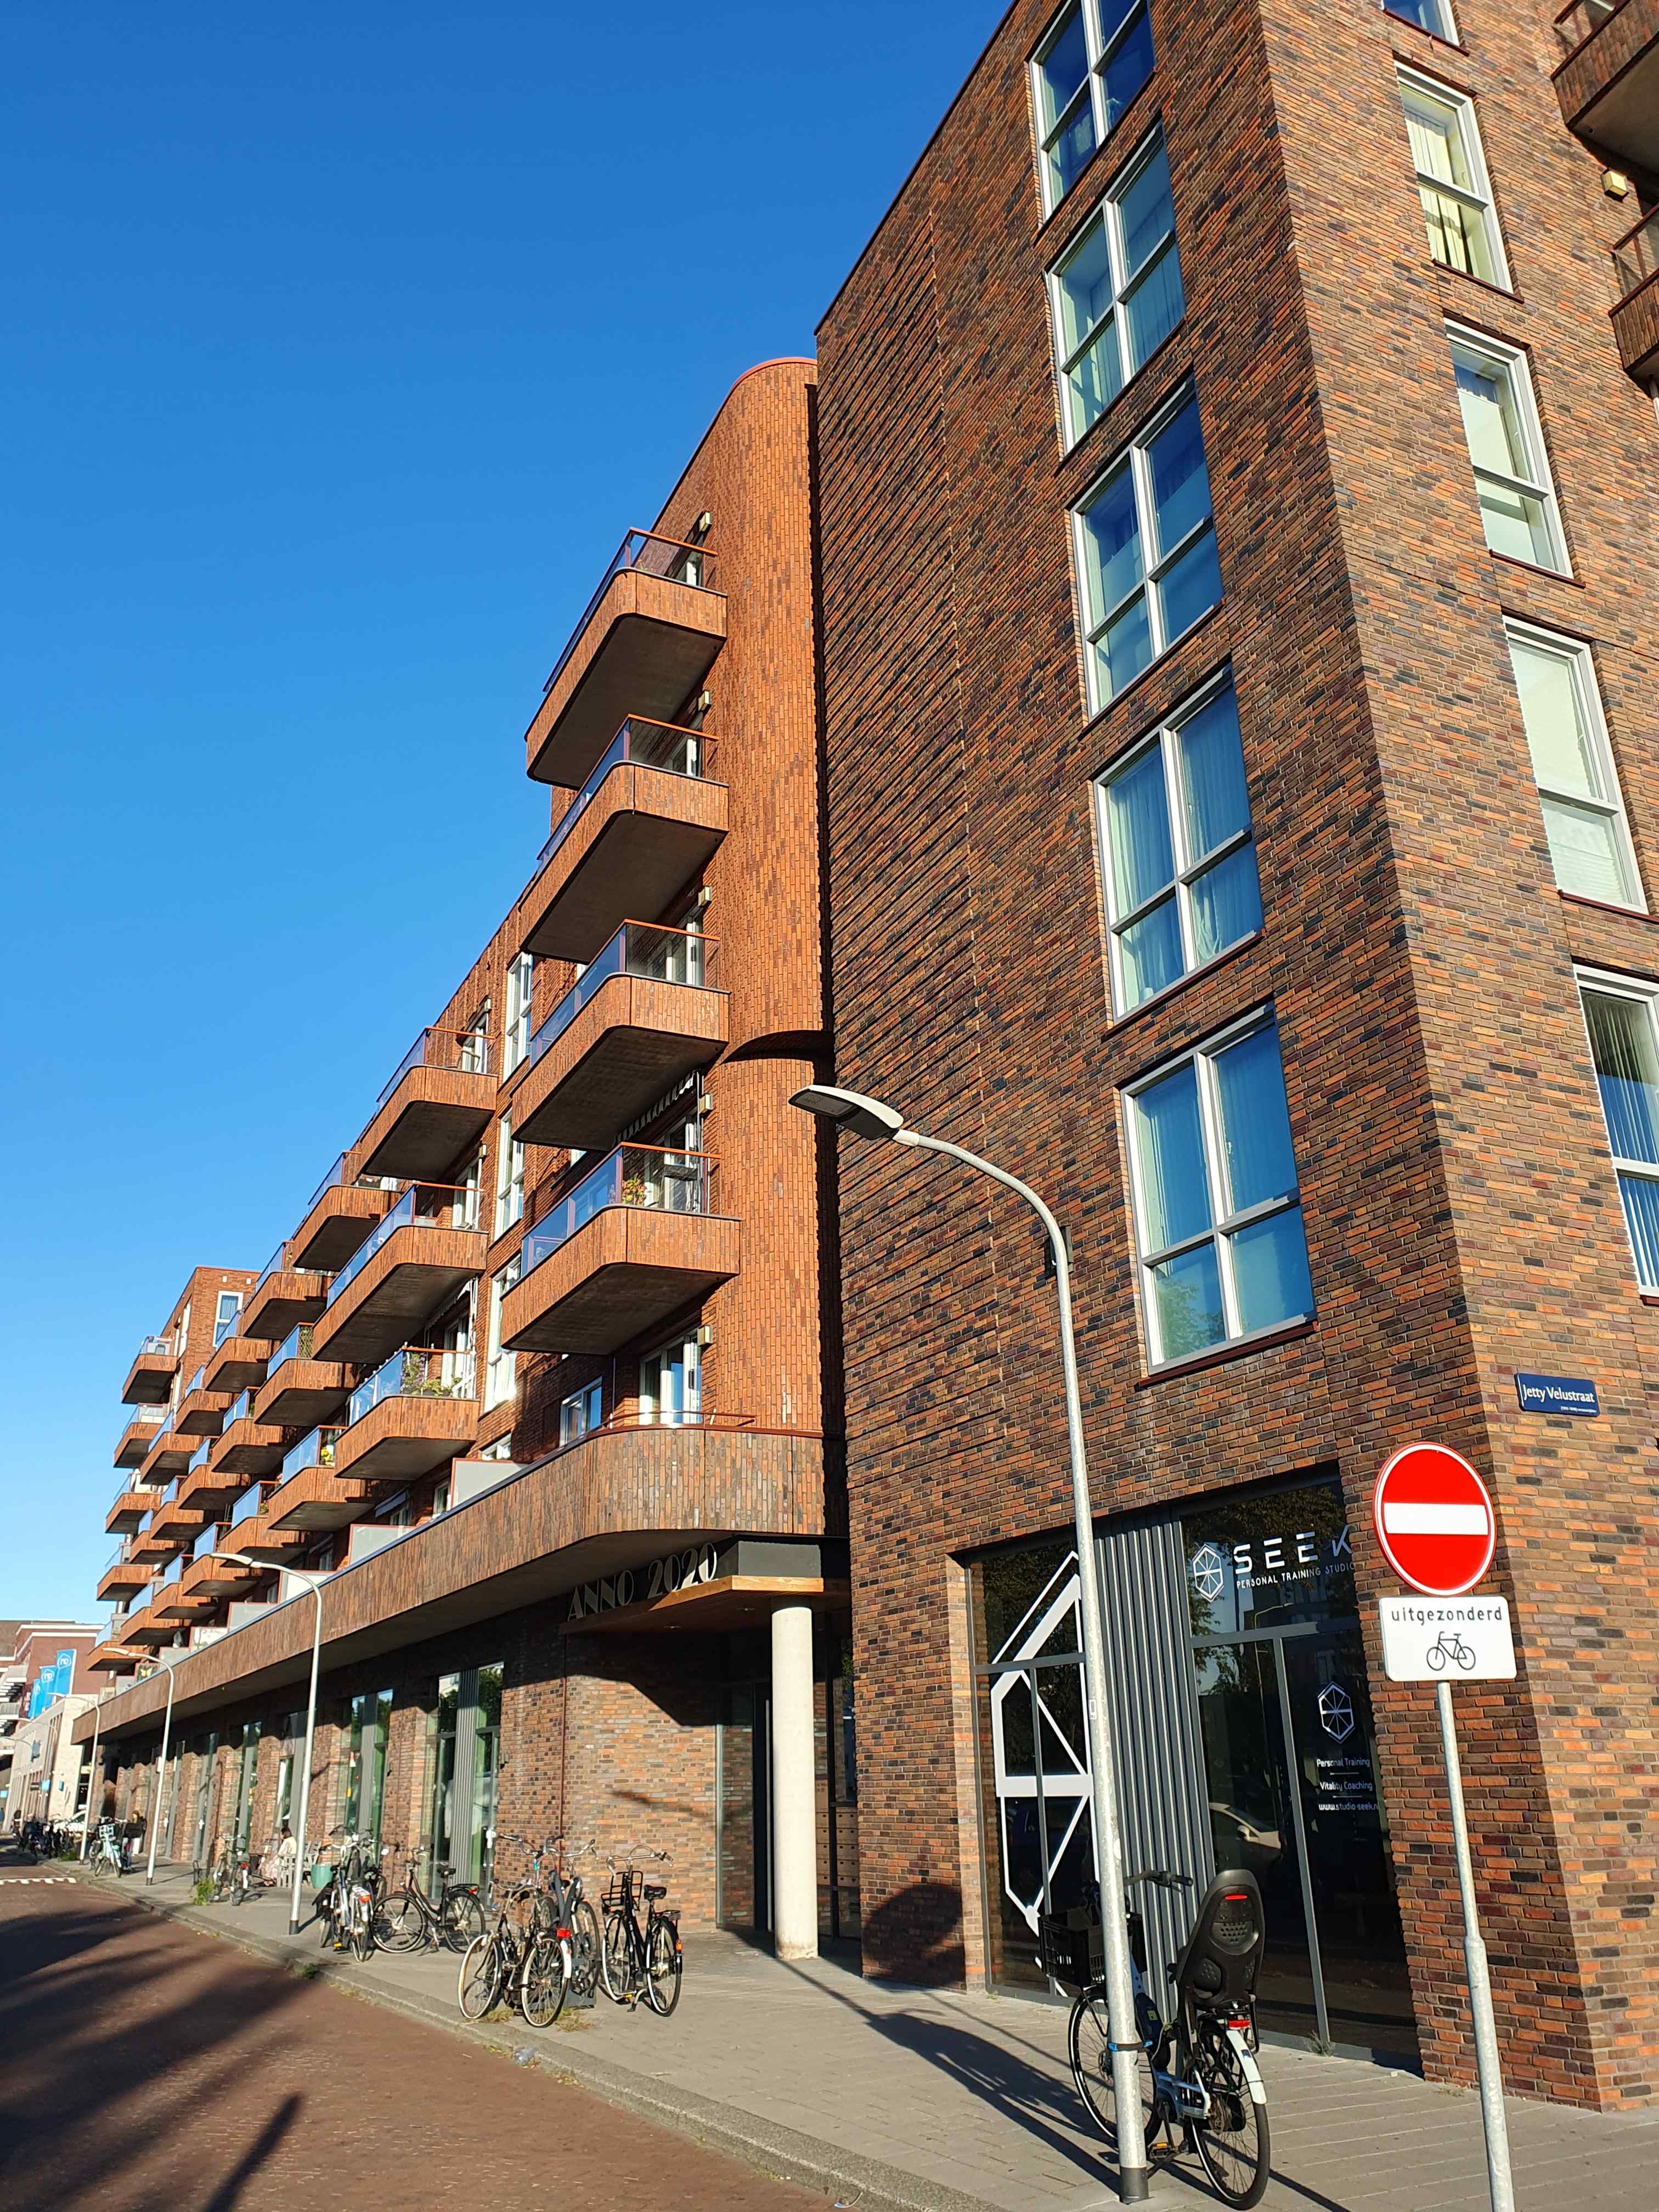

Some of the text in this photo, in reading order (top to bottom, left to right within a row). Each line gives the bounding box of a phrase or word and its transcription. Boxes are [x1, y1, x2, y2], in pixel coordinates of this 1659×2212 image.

[1523, 1384, 1595, 1402] Jetty Velustraat
[1234, 1523, 1352, 1574] SEEK
[567, 1542, 718, 1622] ANNO 2020
[1237, 1576, 1278, 1589] PERSONAL
[1281, 1567, 1321, 1582] TRAINING
[1391, 1606, 1502, 1626] uitgezonderd
[1317, 1757, 1370, 1767] Personal Training
[1319, 1781, 1373, 1792] Vitality Coaching
[1318, 1802, 1378, 1810] www.studio-seek.n
